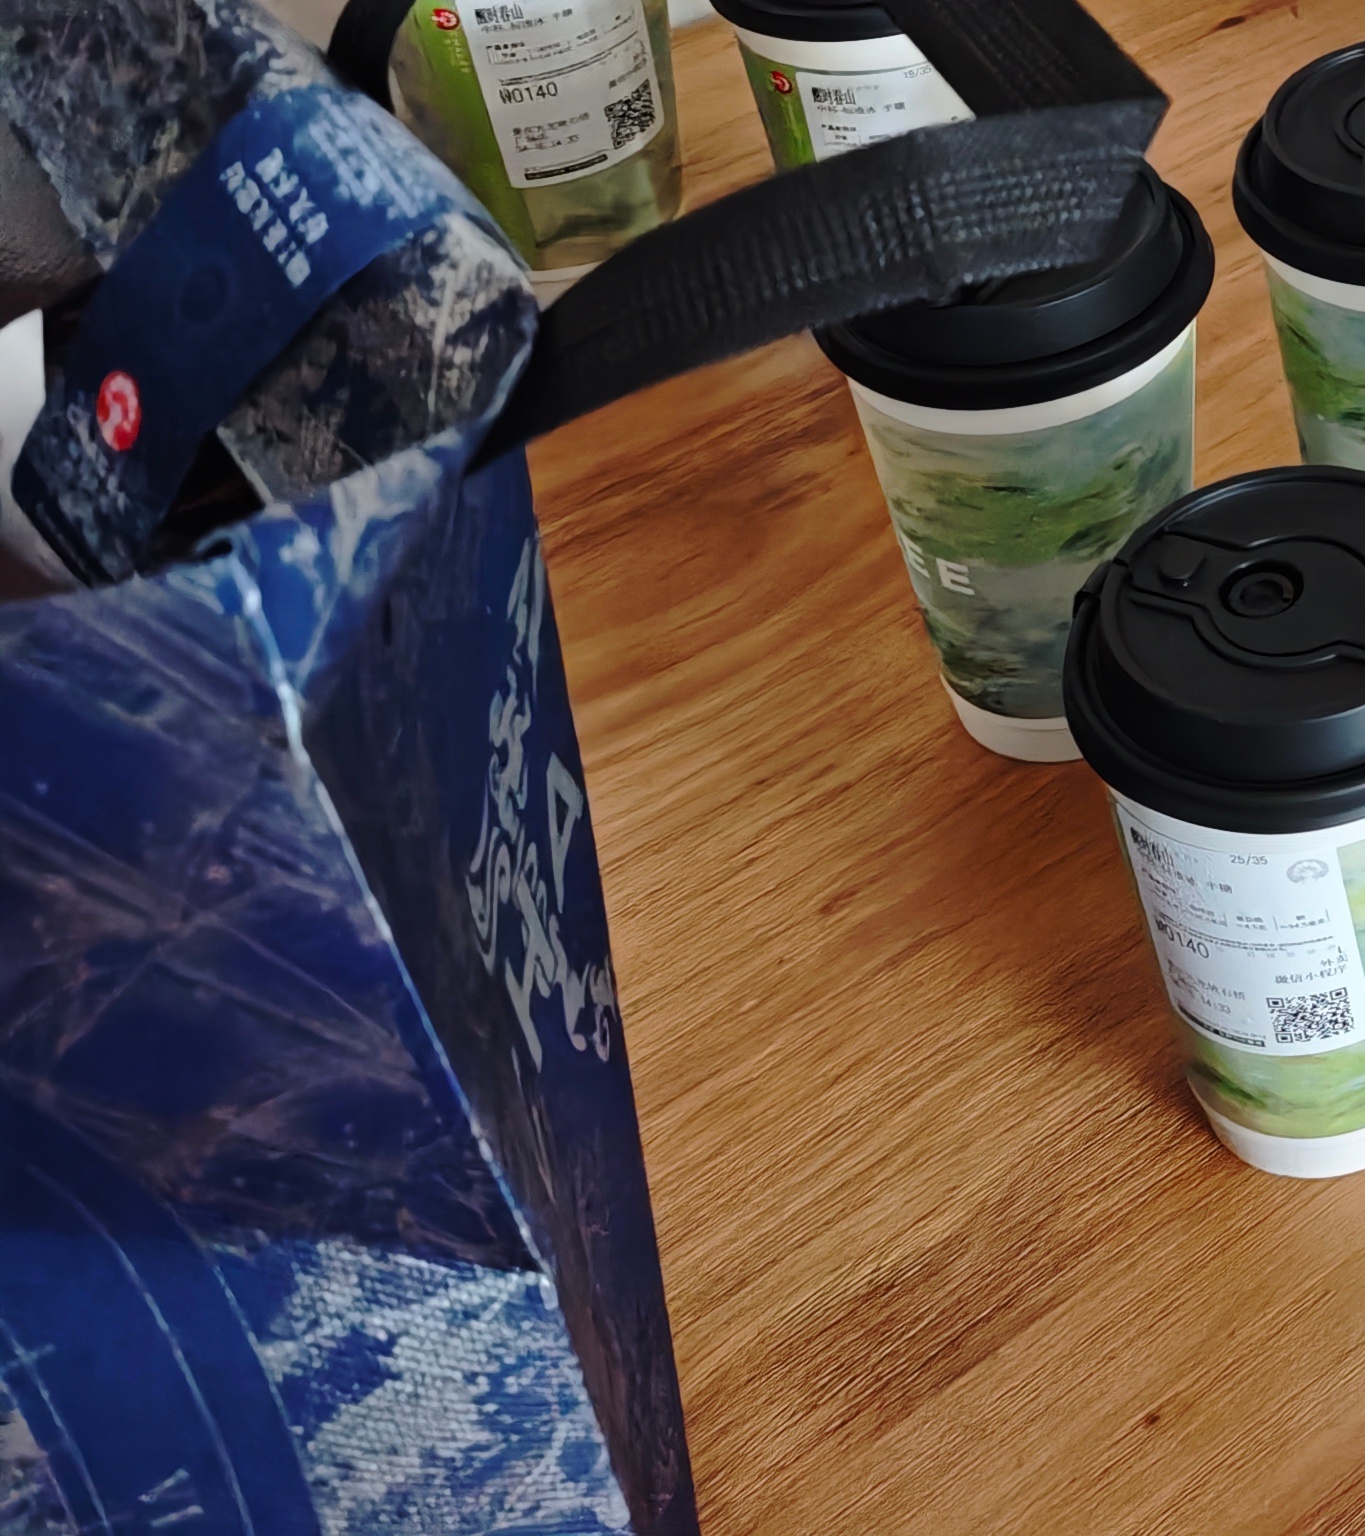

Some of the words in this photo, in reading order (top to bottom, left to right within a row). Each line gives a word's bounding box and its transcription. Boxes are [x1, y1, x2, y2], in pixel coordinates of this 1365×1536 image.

[498, 82, 558, 104] W0140
[1229, 853, 1269, 866] 25/35
[1274, 964, 1348, 984] 微信小程序
